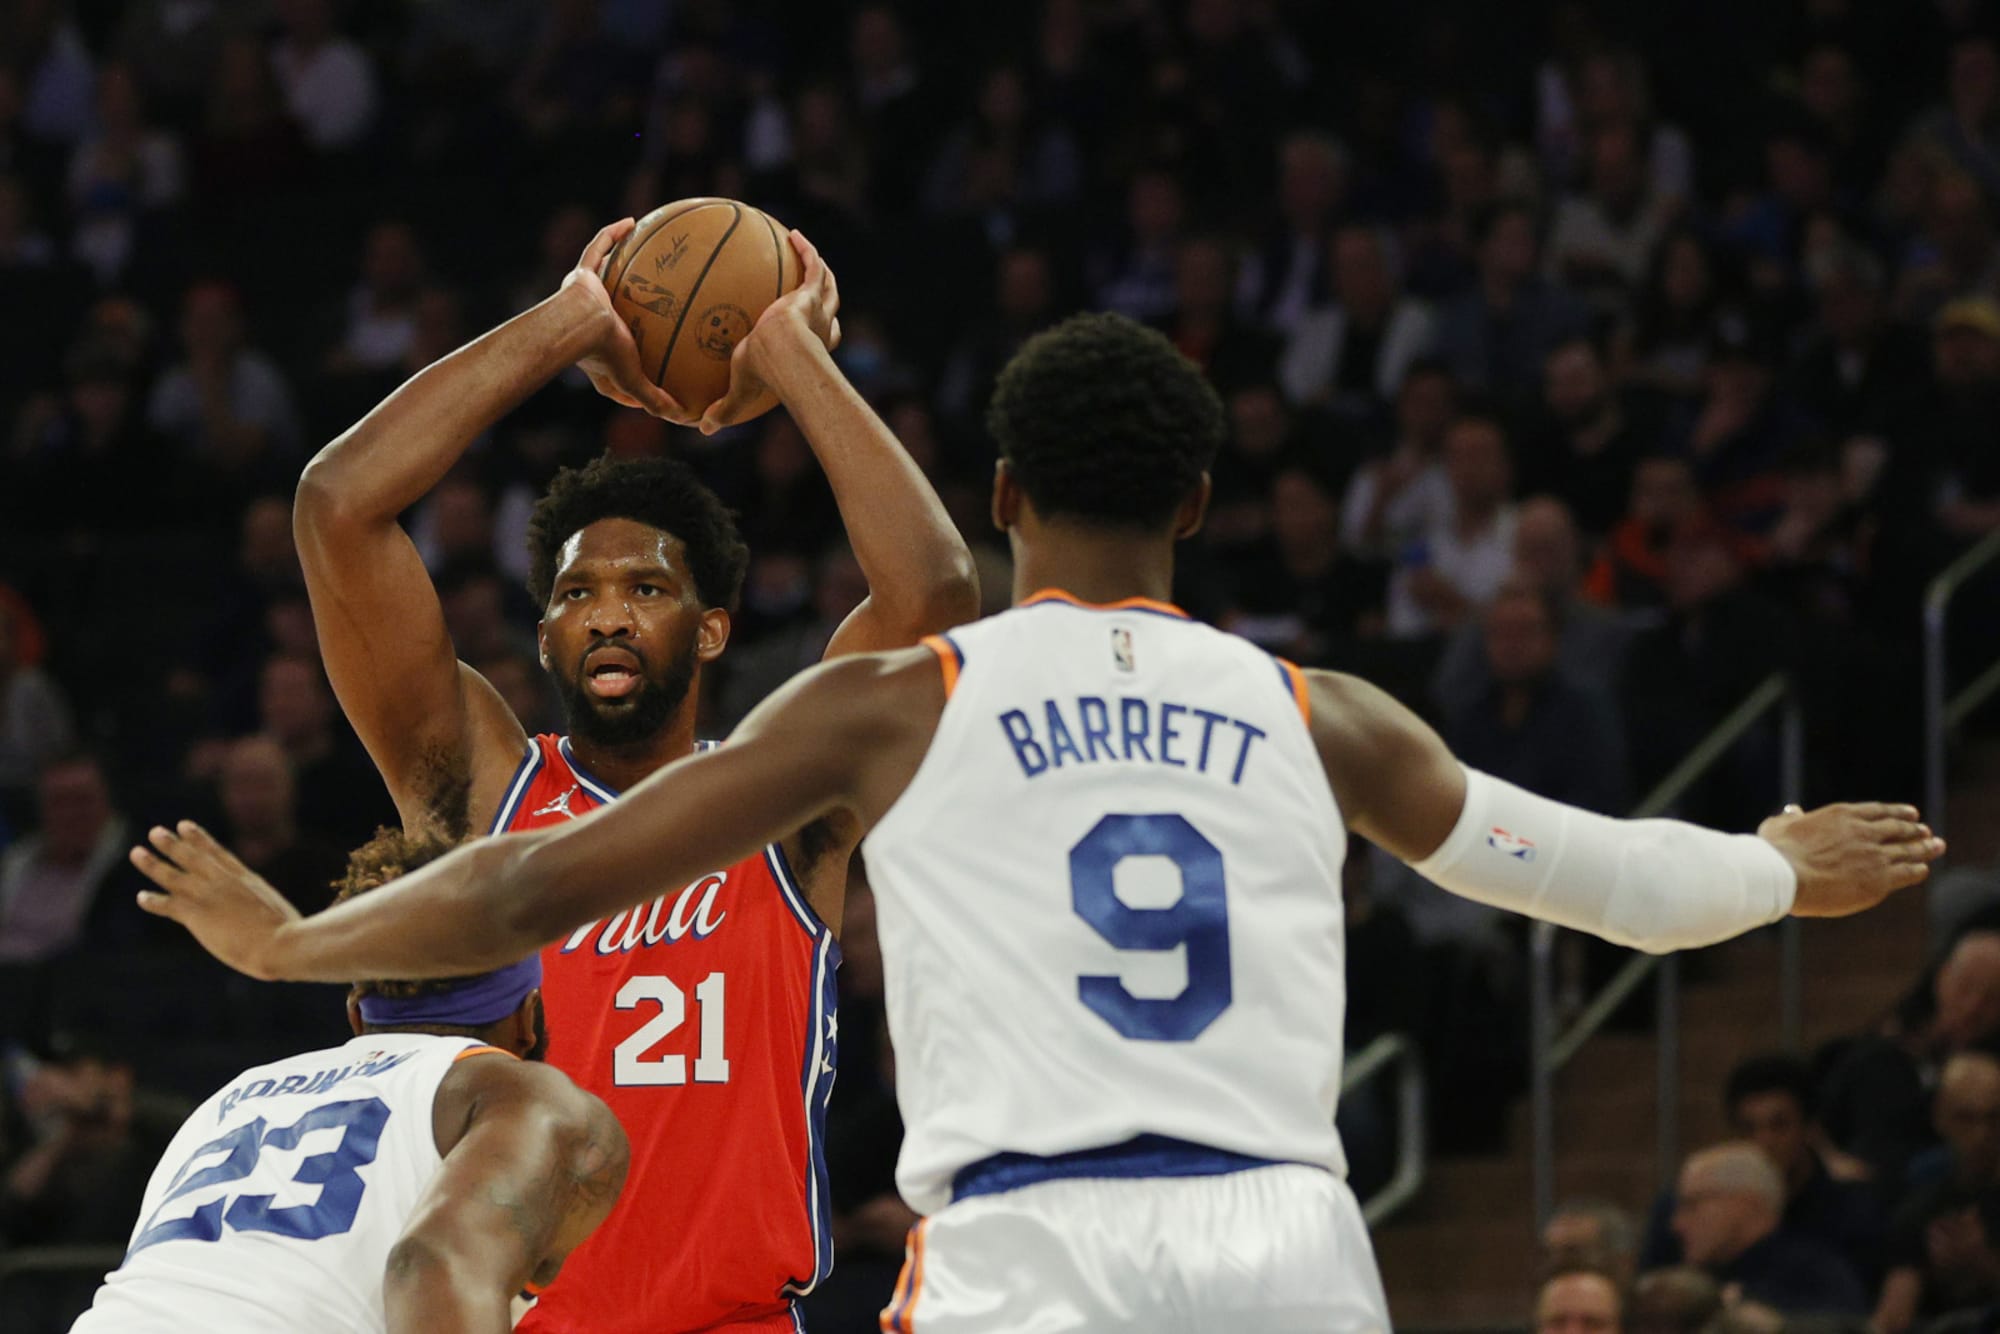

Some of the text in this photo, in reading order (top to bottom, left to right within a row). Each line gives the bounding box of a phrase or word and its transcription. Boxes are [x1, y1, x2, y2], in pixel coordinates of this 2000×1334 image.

[999, 696, 1267, 785] BARRETT
[1069, 813, 1233, 1042] 9
[614, 972, 729, 1086] 21
[120, 1096, 392, 1271] 23
